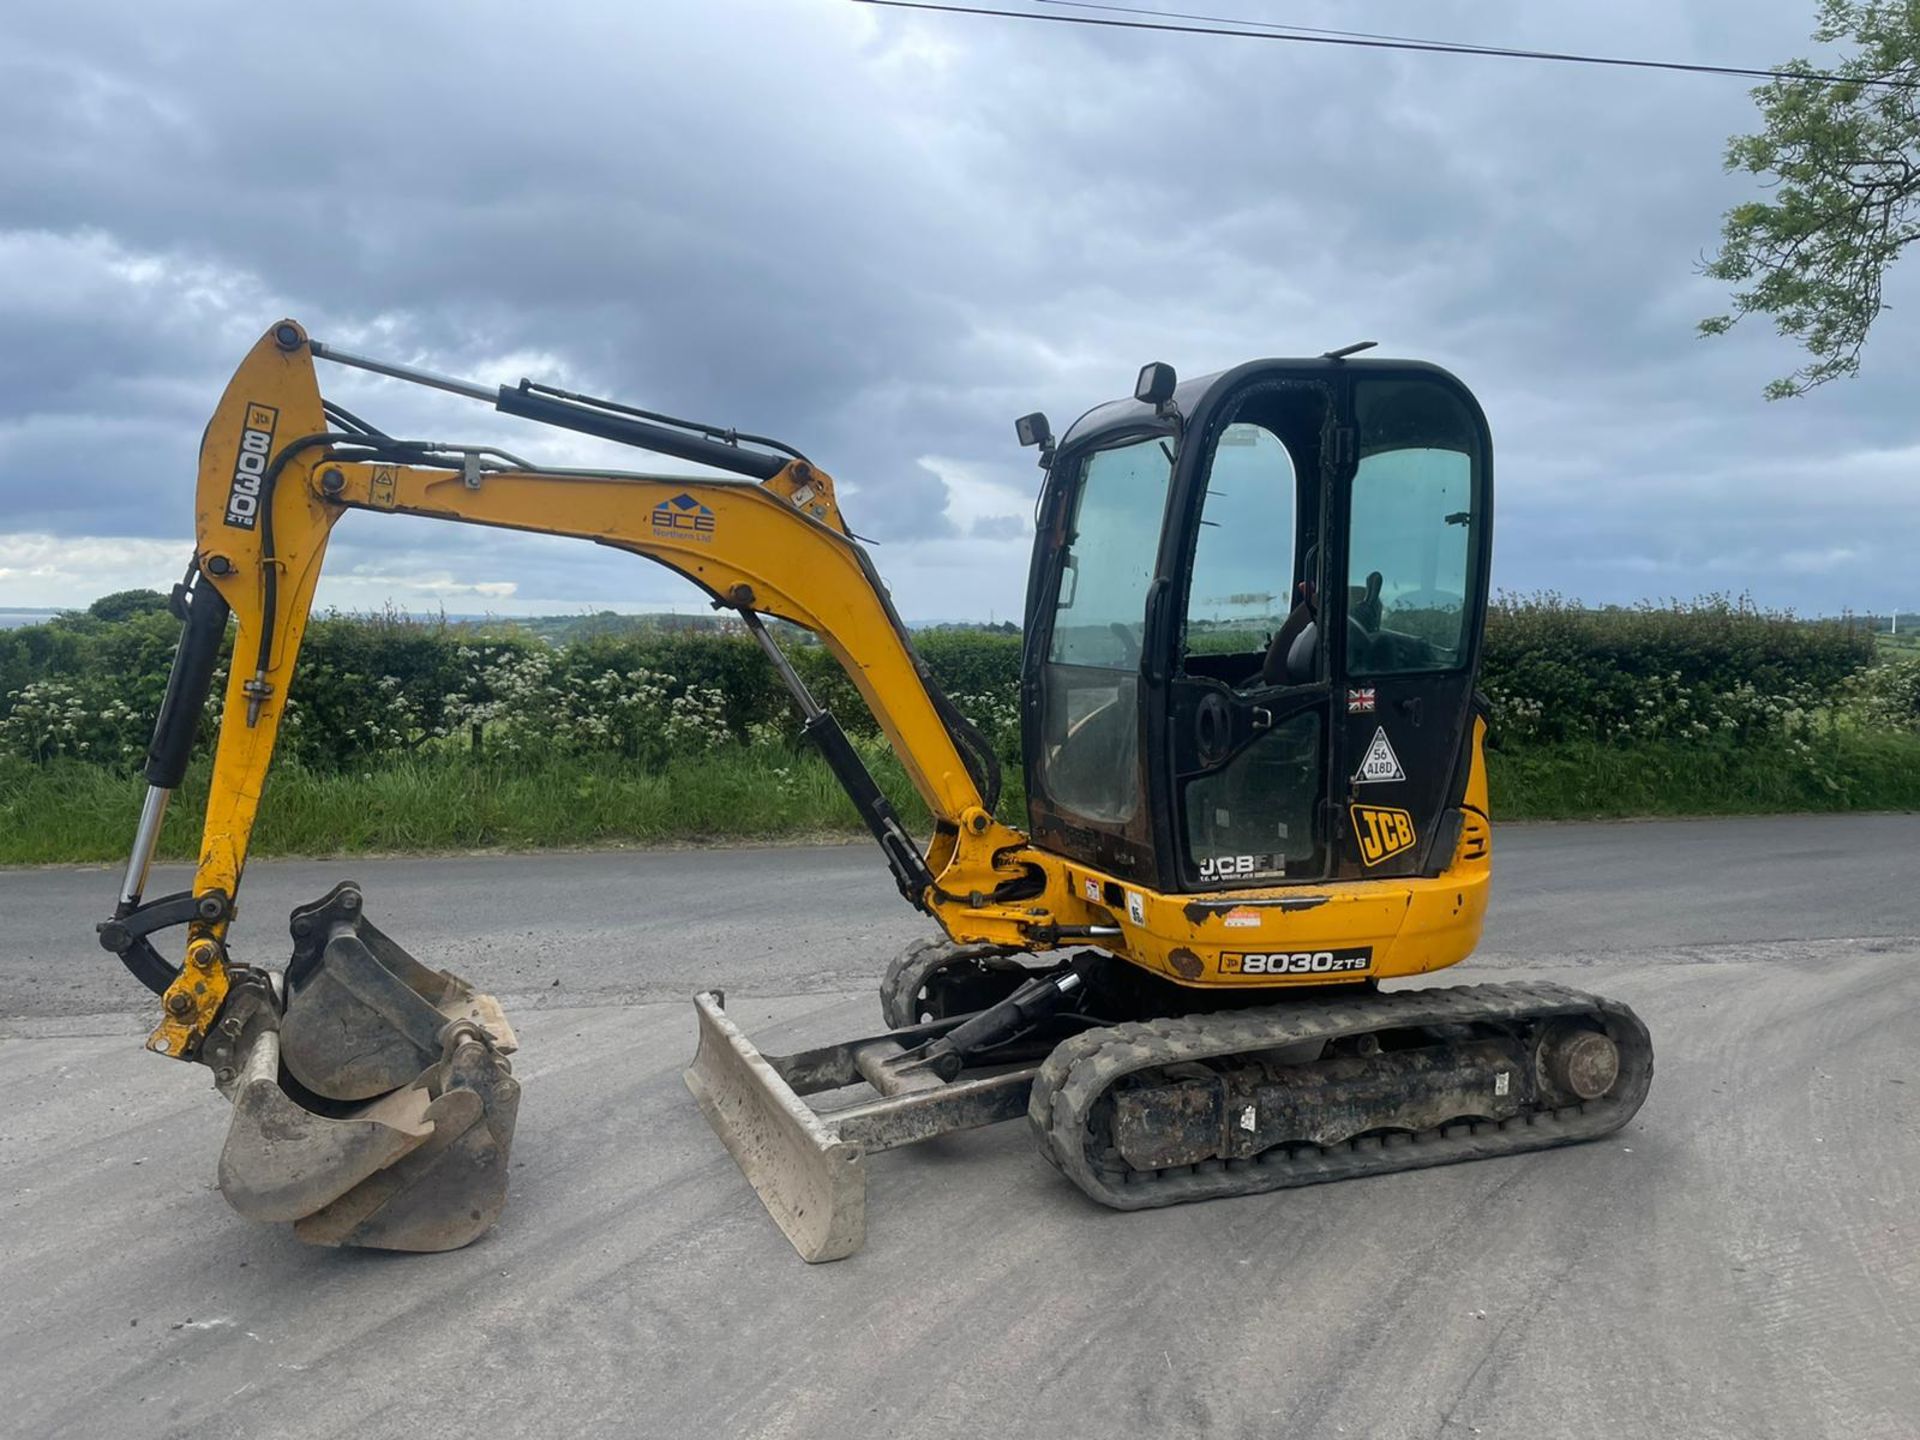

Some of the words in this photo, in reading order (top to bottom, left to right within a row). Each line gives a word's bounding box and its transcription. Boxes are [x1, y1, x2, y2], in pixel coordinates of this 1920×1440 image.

[652, 510, 715, 532] BCE
[1374, 748, 1387, 760] 56
[1363, 811, 1412, 859] JCB
[1200, 855, 1254, 875] JCB
